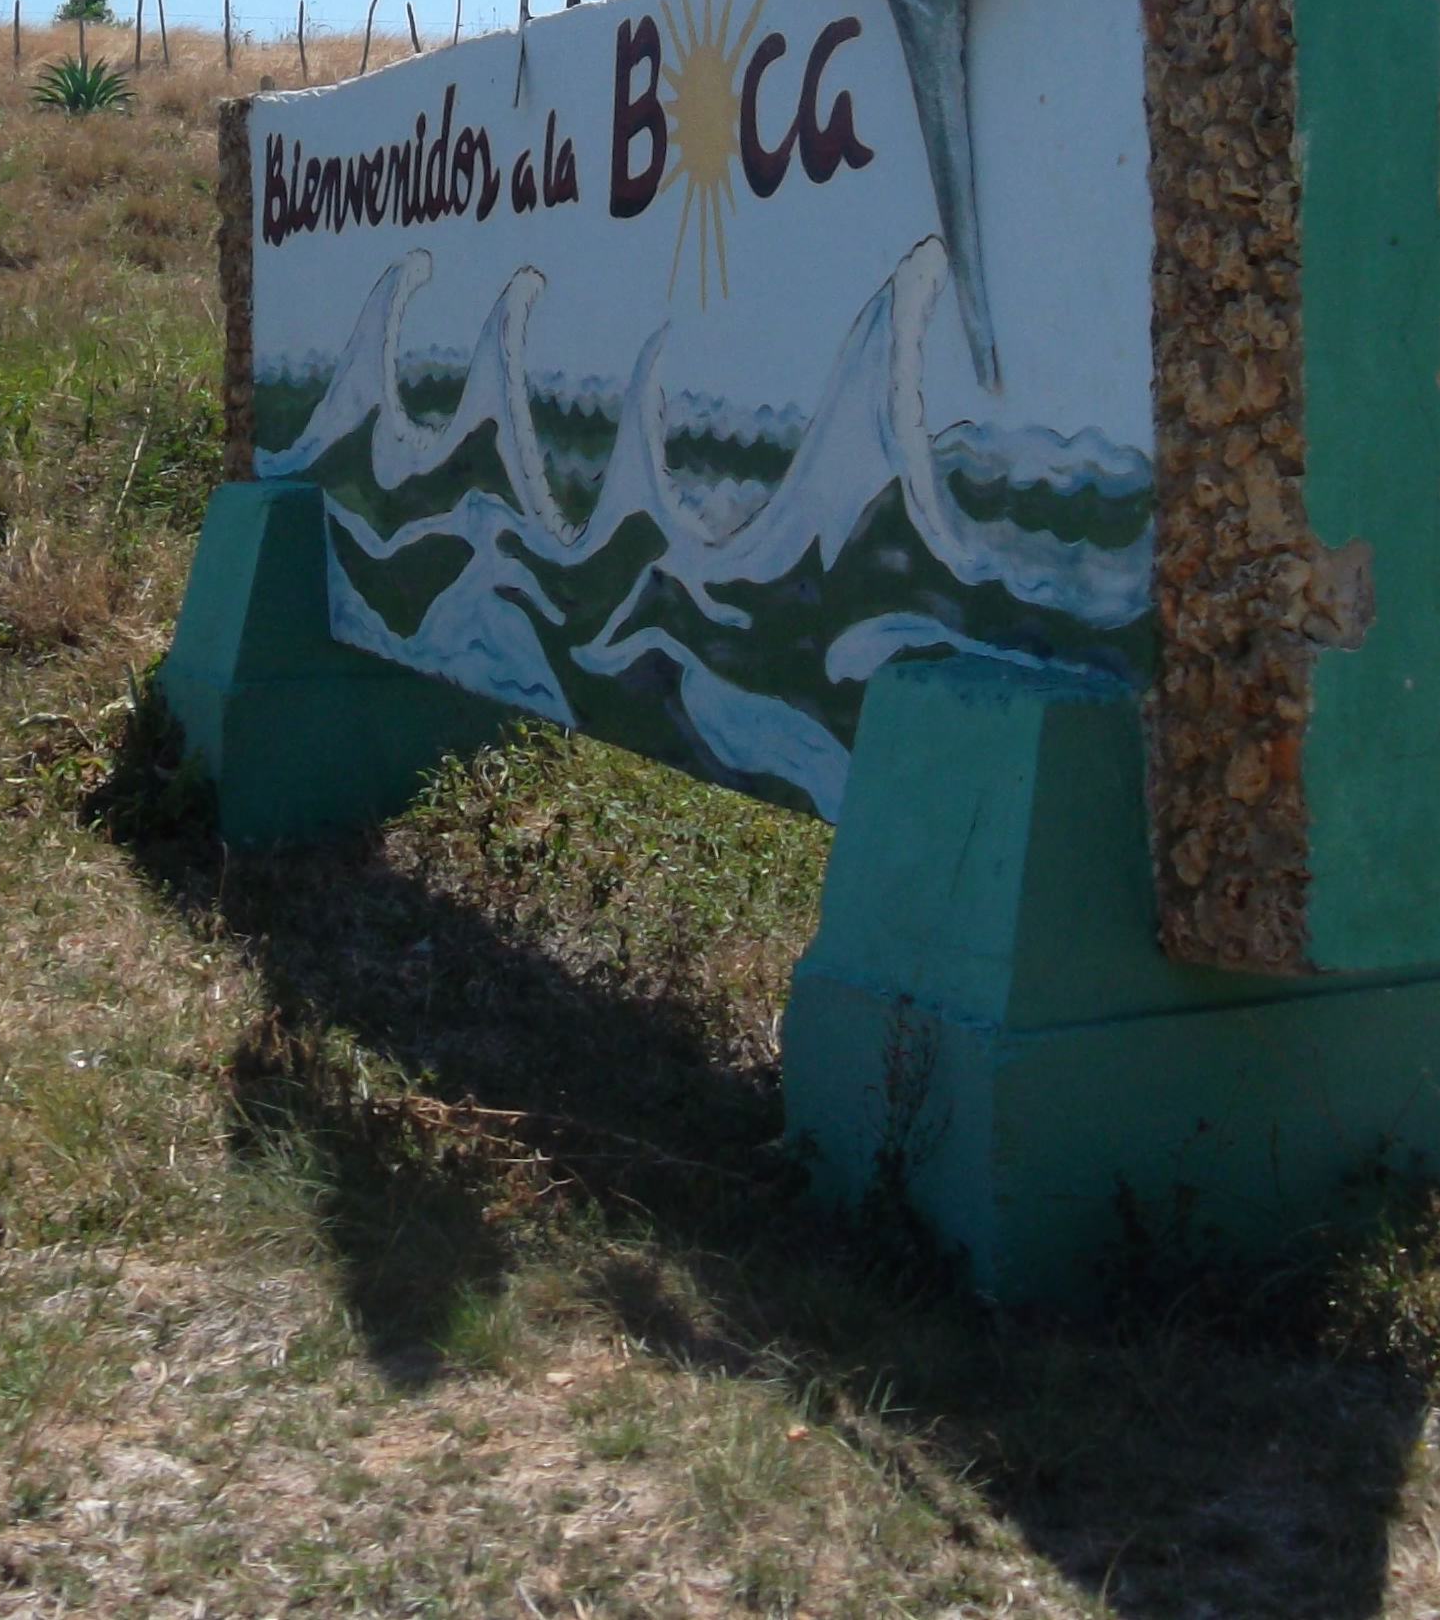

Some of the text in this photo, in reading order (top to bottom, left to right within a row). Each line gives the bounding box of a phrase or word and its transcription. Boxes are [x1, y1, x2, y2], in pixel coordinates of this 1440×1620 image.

[262, 82, 501, 247] Bienvenidos
[510, 147, 538, 215] a
[542, 108, 580, 209] la
